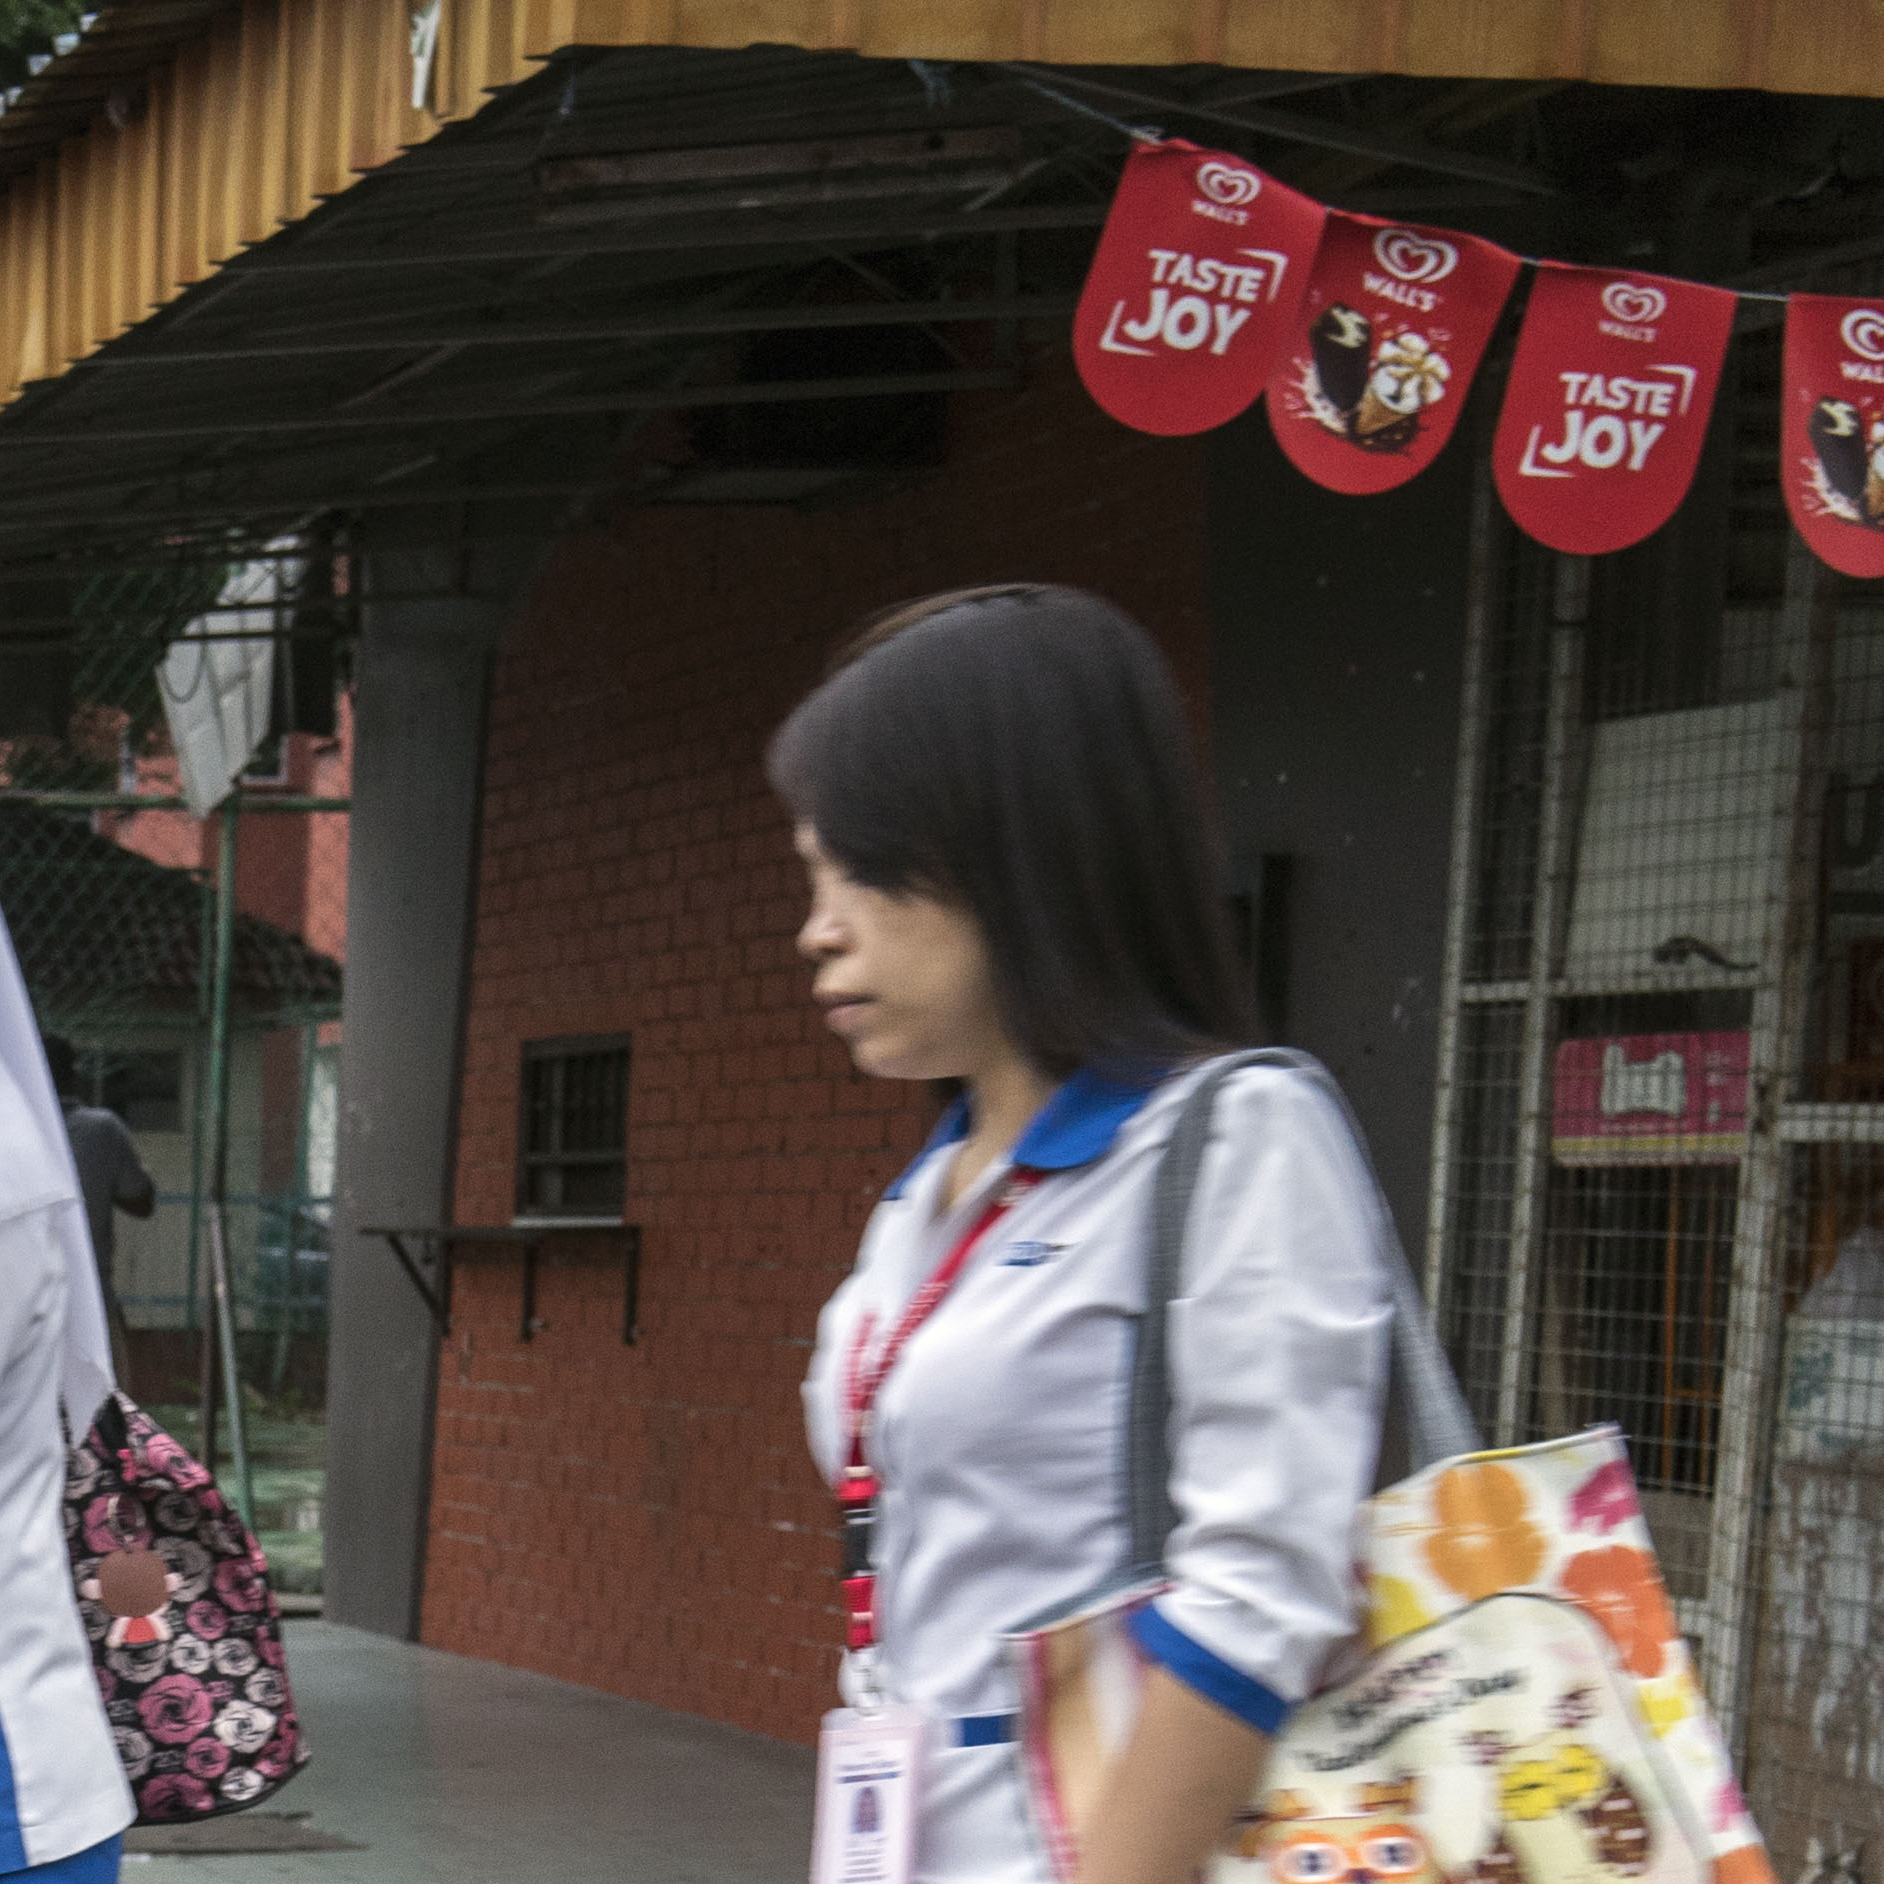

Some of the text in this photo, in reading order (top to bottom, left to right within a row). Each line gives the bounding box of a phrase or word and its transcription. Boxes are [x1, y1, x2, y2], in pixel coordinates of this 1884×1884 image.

[1191, 200, 1251, 226] WALL'S
[1148, 248, 1265, 303] TASTE
[1363, 270, 1438, 313] WALL'S
[1122, 288, 1252, 356] JOY
[1598, 319, 1656, 343] WALL'S
[1559, 370, 1677, 418] TASTE
[1840, 361, 1884, 384] WAL
[1541, 409, 1666, 472] JOY
